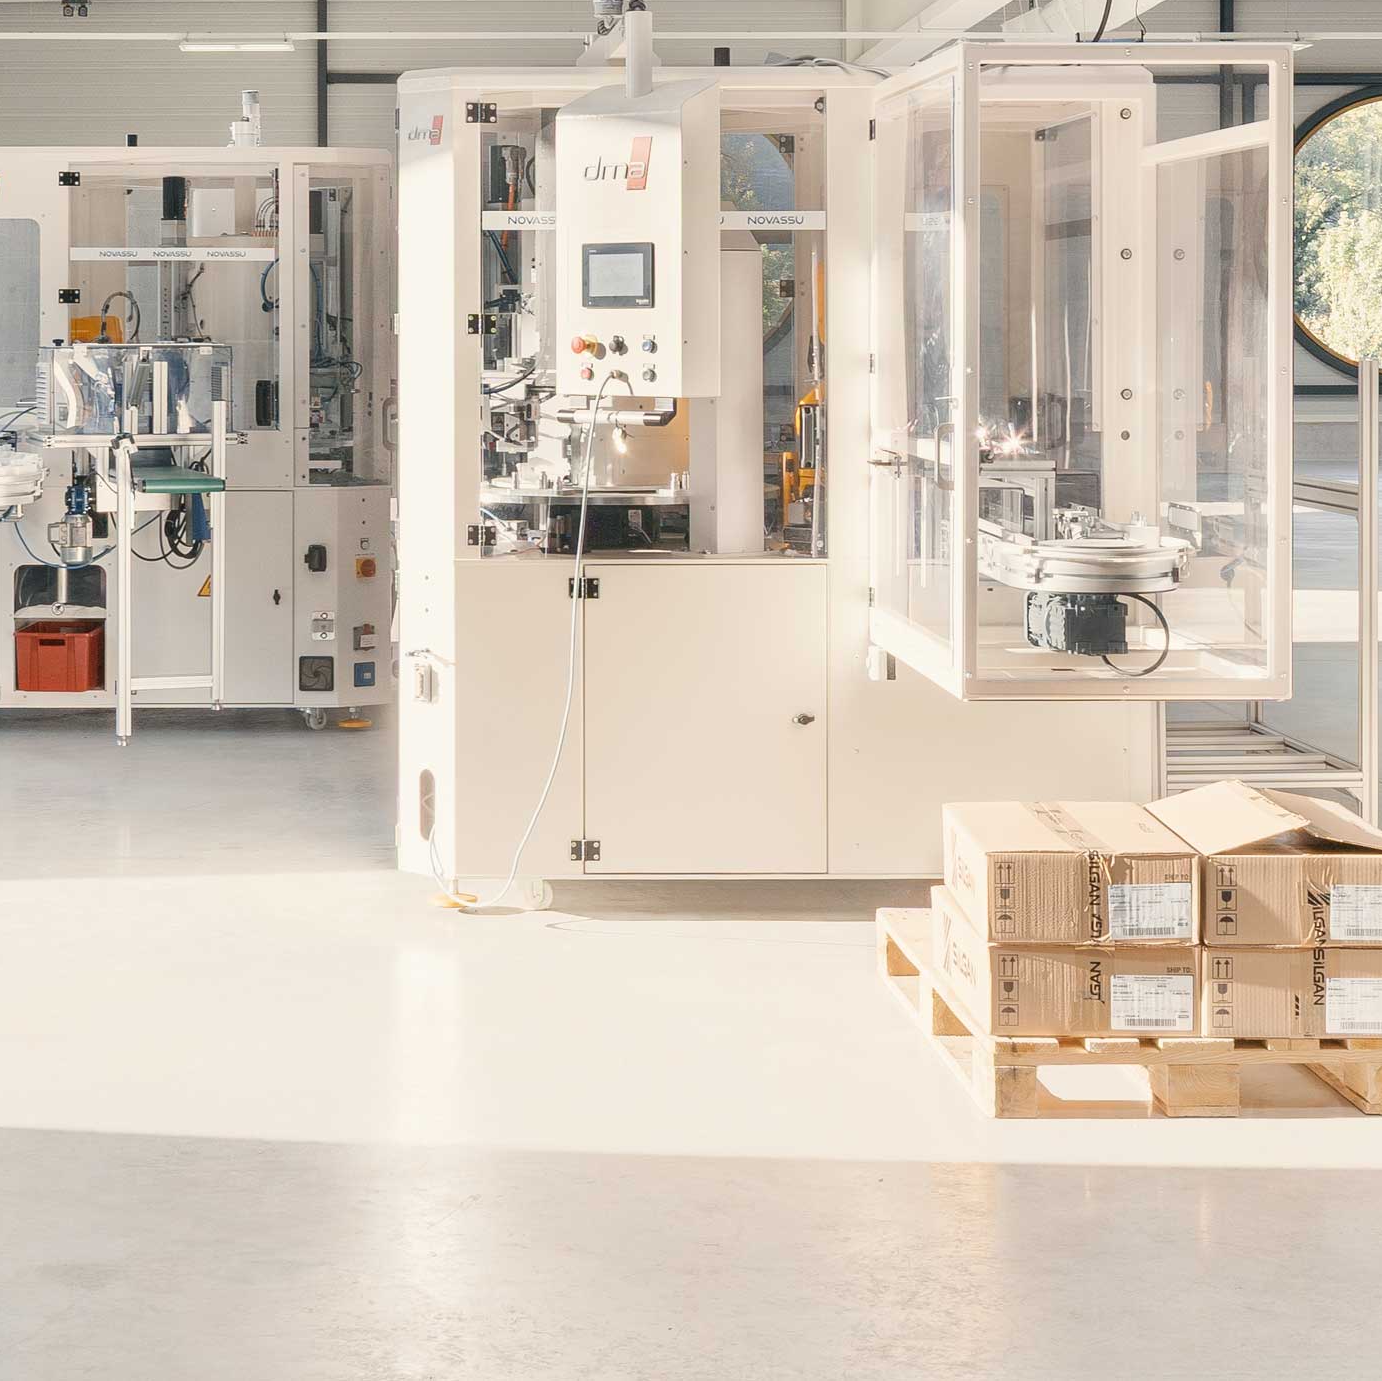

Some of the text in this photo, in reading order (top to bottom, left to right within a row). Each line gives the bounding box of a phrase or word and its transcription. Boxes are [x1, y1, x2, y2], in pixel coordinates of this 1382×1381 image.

[584, 156, 646, 180] dma
[507, 216, 556, 225] NOVASS
[747, 216, 804, 225] NOVASSU
[99, 250, 246, 258] NOVASSU NOVASSU NOVASSU
[1313, 948, 1325, 1006] SILGAN
